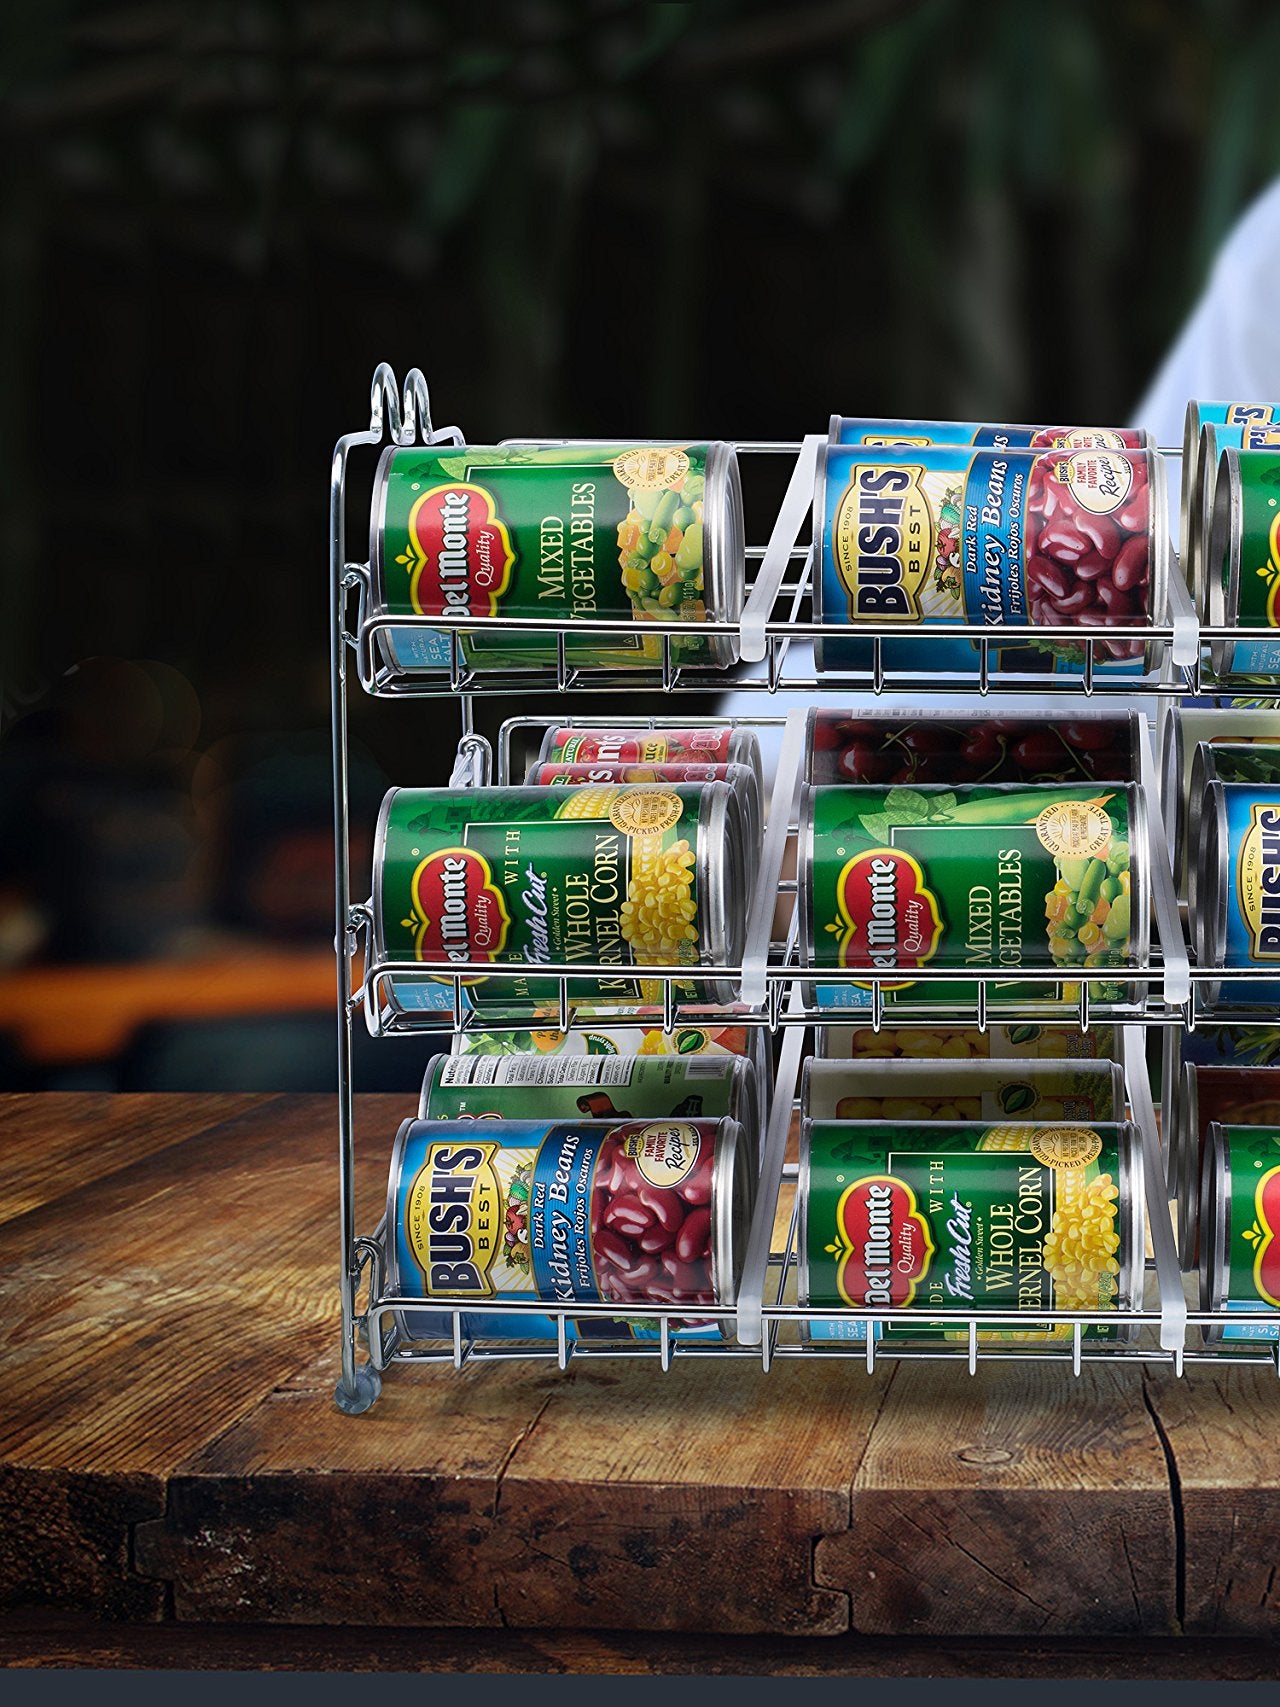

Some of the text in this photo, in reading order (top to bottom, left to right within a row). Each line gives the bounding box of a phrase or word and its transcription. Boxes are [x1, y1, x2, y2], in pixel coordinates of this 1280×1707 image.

[981, 460, 1008, 527] Beans
[1076, 462, 1087, 483] FAMILY
[1087, 460, 1097, 489] FAVORITE
[1099, 456, 1121, 498] Recipes
[437, 492, 470, 580] Monte
[474, 530, 494, 586] Quality
[536, 516, 566, 600] MIXED
[842, 506, 853, 572] SINCE 1908
[857, 470, 910, 614] BUSH'S
[908, 505, 920, 573] BEST
[965, 506, 978, 573] Dark Red
[1007, 473, 1024, 615] Frijoles Rojos Oscuros
[1267, 648, 1280, 669] SEA
[563, 738, 581, 763] ATURAL
[628, 826, 659, 835] PICKED
[1039, 806, 1060, 852] GUARANTEED
[1088, 806, 1109, 851] GREAT TASTE
[440, 857, 470, 963] el Monte
[590, 834, 627, 990] KRNEL CORN
[1246, 846, 1256, 912] SINCE 1908
[474, 895, 492, 946] Quality
[504, 830, 529, 996] MAE WITH
[522, 863, 551, 964] Fresh Cut
[553, 894, 562, 946] Golden Sweet
[564, 873, 592, 961] WHOLE
[866, 858, 898, 968] el Monte
[904, 900, 924, 952] Quality
[965, 885, 993, 964] MIXED
[627, 1134, 641, 1156] BUSH'S
[644, 1135, 657, 1158] FAMILY
[654, 1132, 668, 1162] FAVORITE
[665, 1127, 690, 1171] Recipes
[1049, 1159, 1081, 1168] PICKED
[412, 1185, 426, 1251] SINCE 1908
[429, 1147, 485, 1290] BUSH'S
[478, 1183, 491, 1250] BEST
[533, 1183, 546, 1249] Dark Red
[548, 1135, 580, 1301] Kidney Beans
[574, 1148, 593, 1288] Frijoles Rojos Oscuros
[929, 1160, 944, 1213] WITH
[864, 1185, 892, 1266] Monte
[897, 1222, 916, 1274] Quality
[944, 1191, 975, 1300] Fresh Cut
[975, 1223, 985, 1276] Golden Sweet
[986, 1204, 1014, 1291] WHOLE
[1015, 1166, 1043, 1311] ERNEL CORN
